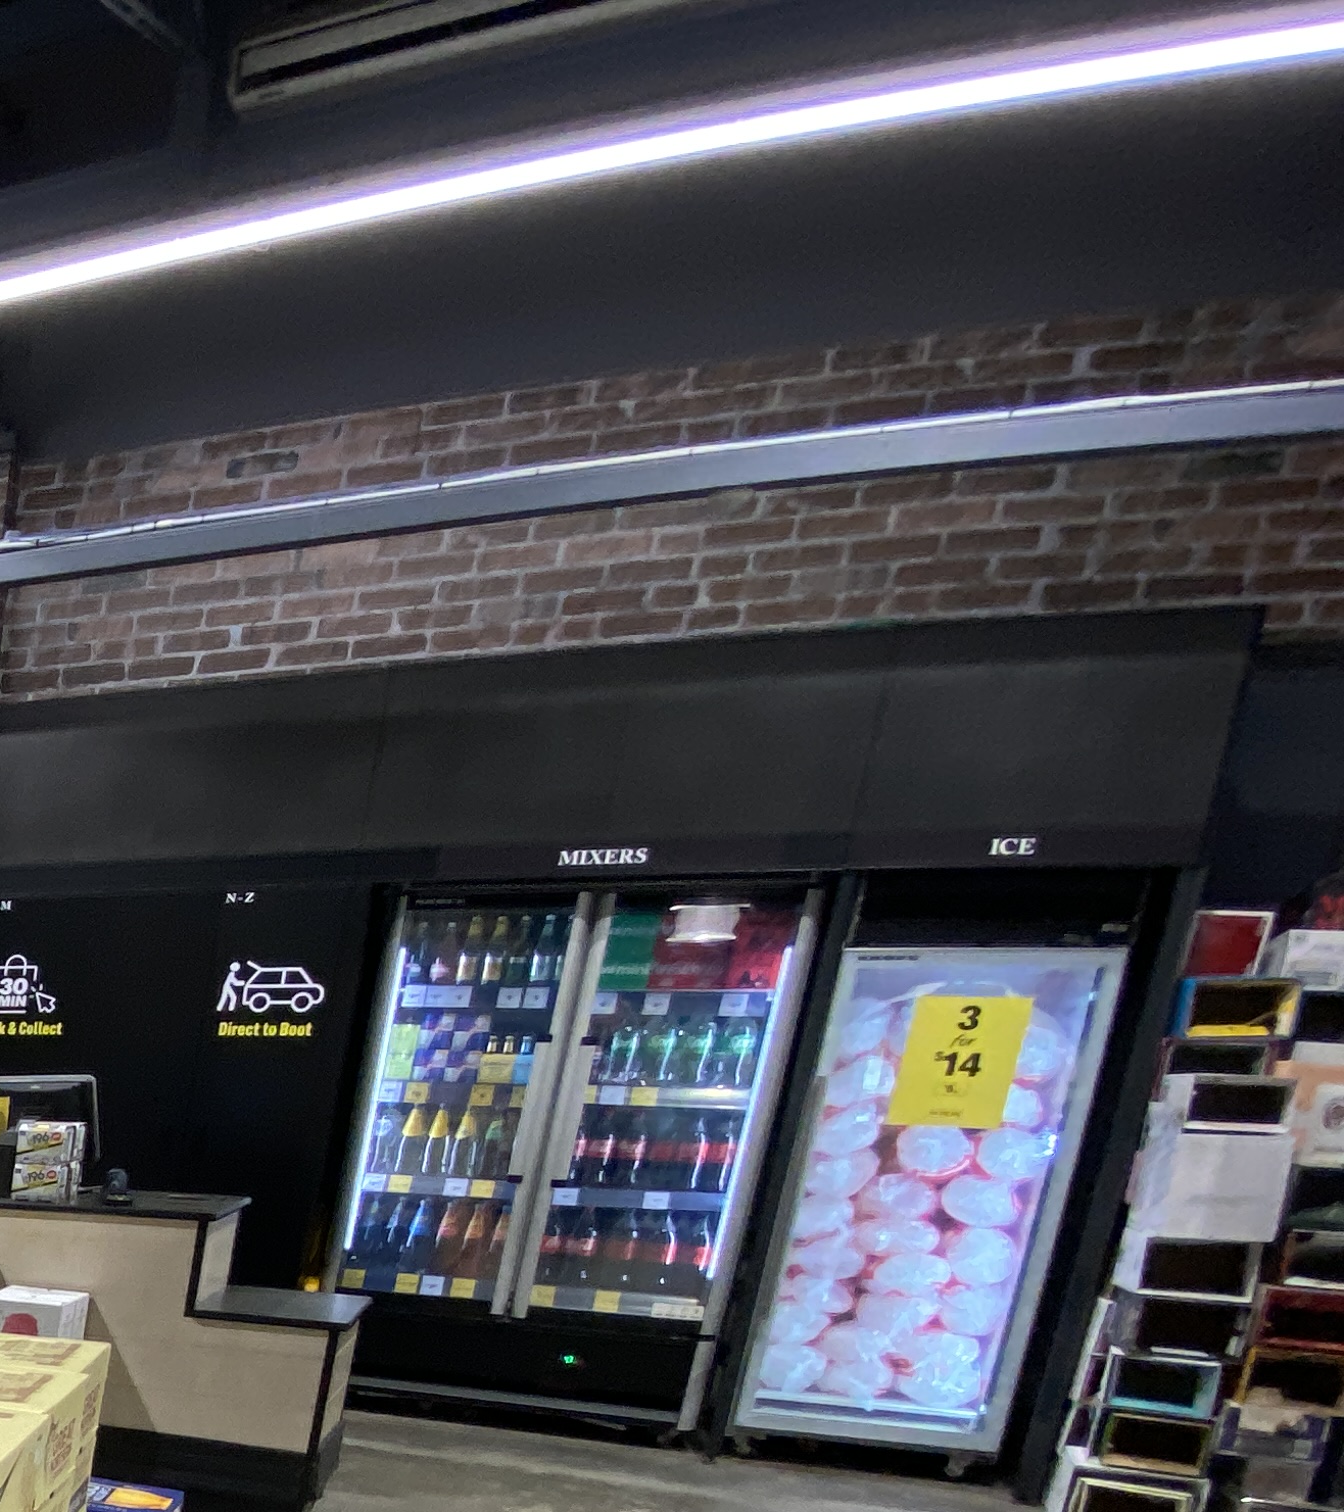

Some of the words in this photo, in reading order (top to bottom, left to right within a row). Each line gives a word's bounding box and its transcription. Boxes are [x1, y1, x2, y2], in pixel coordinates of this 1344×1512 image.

[988, 837, 1036, 856] ICE
[557, 848, 649, 866] MIXERS
[225, 892, 255, 903] N-Z
[0, 978, 28, 995] 30
[958, 1005, 981, 1030] 3
[8, 1023, 17, 1035] &
[18, 1021, 63, 1035] Collect
[218, 1022, 259, 1036] Direct
[262, 1022, 277, 1036] to
[280, 1022, 312, 1036] Boot
[950, 1035, 976, 1048] for
[934, 1051, 981, 1077] $14
